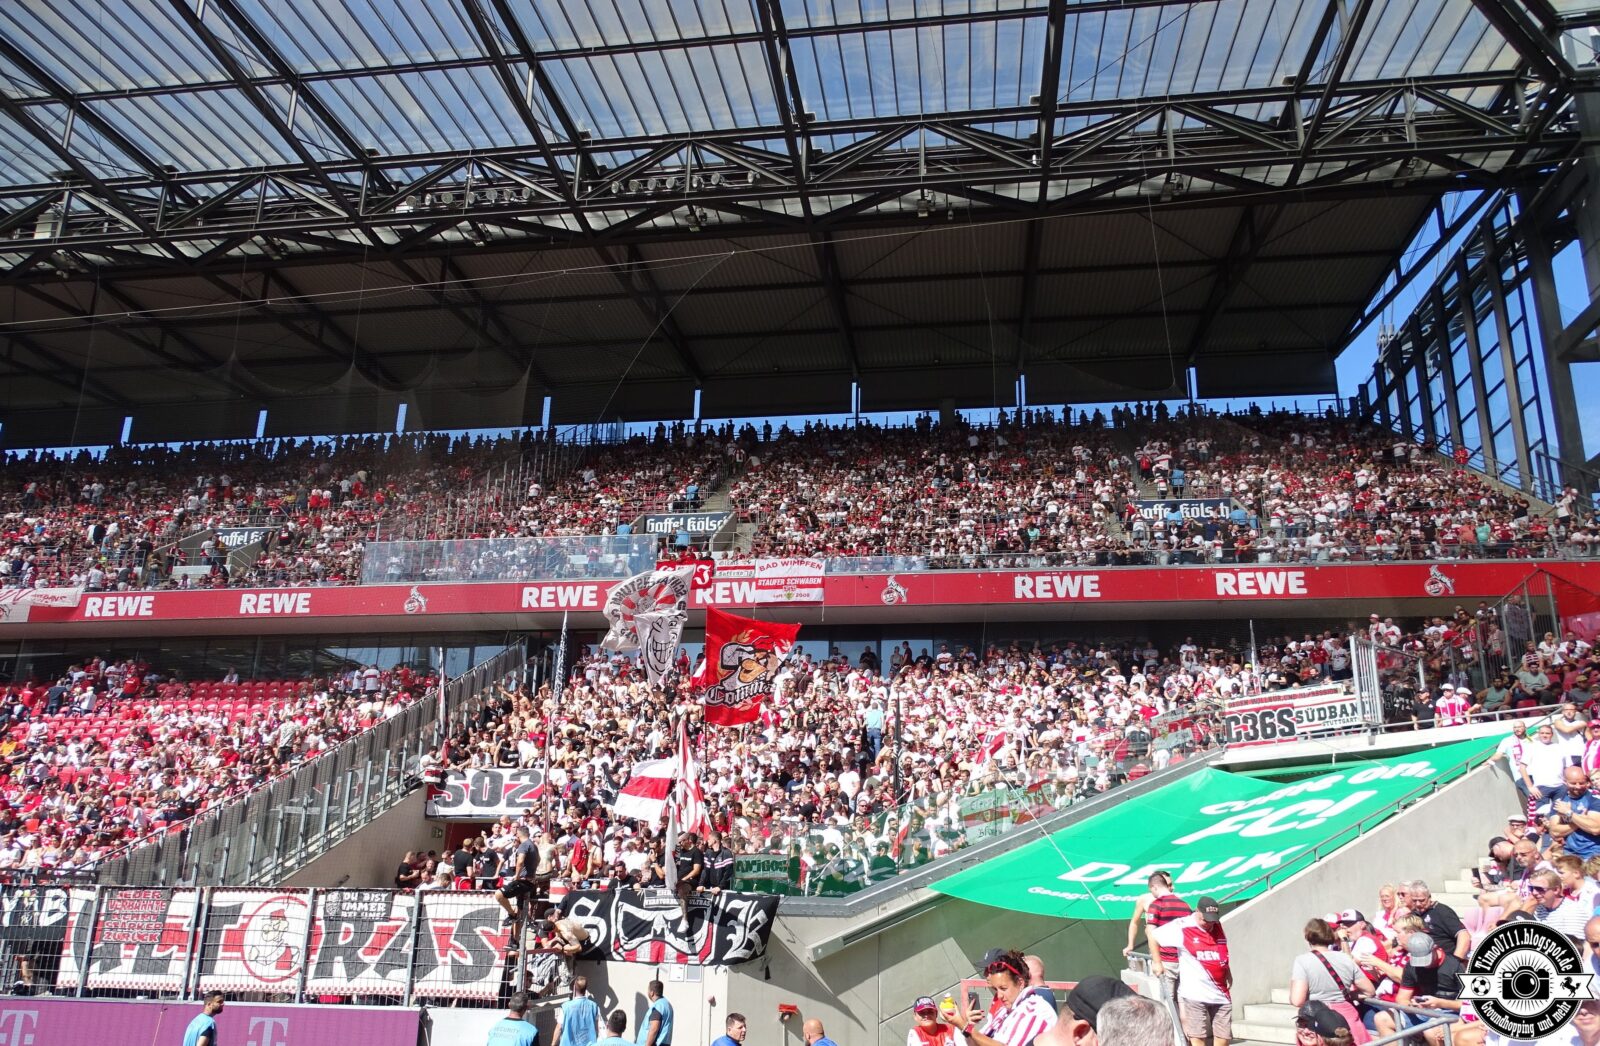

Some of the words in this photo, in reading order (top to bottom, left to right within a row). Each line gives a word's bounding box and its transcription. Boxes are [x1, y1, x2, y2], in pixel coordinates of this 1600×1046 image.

[1179, 502, 1230, 519] Kölsh
[758, 561, 778, 572] BAD
[780, 560, 823, 570] WIMPFEN
[758, 578, 785, 586] STAUFER
[786, 577, 822, 586] SCHWABEN
[1014, 575, 1101, 599] REWE
[1215, 571, 1308, 596] REWE
[239, 593, 312, 614] REWE
[521, 585, 598, 608] REWE
[695, 582, 756, 604] REW
[84, 595, 155, 617] REWE
[1171, 790, 1378, 845] FC!
[1056, 843, 1309, 884] DEVK
[341, 902, 387, 912] IMMER
[342, 891, 359, 901] DU
[362, 892, 389, 902] BIST
